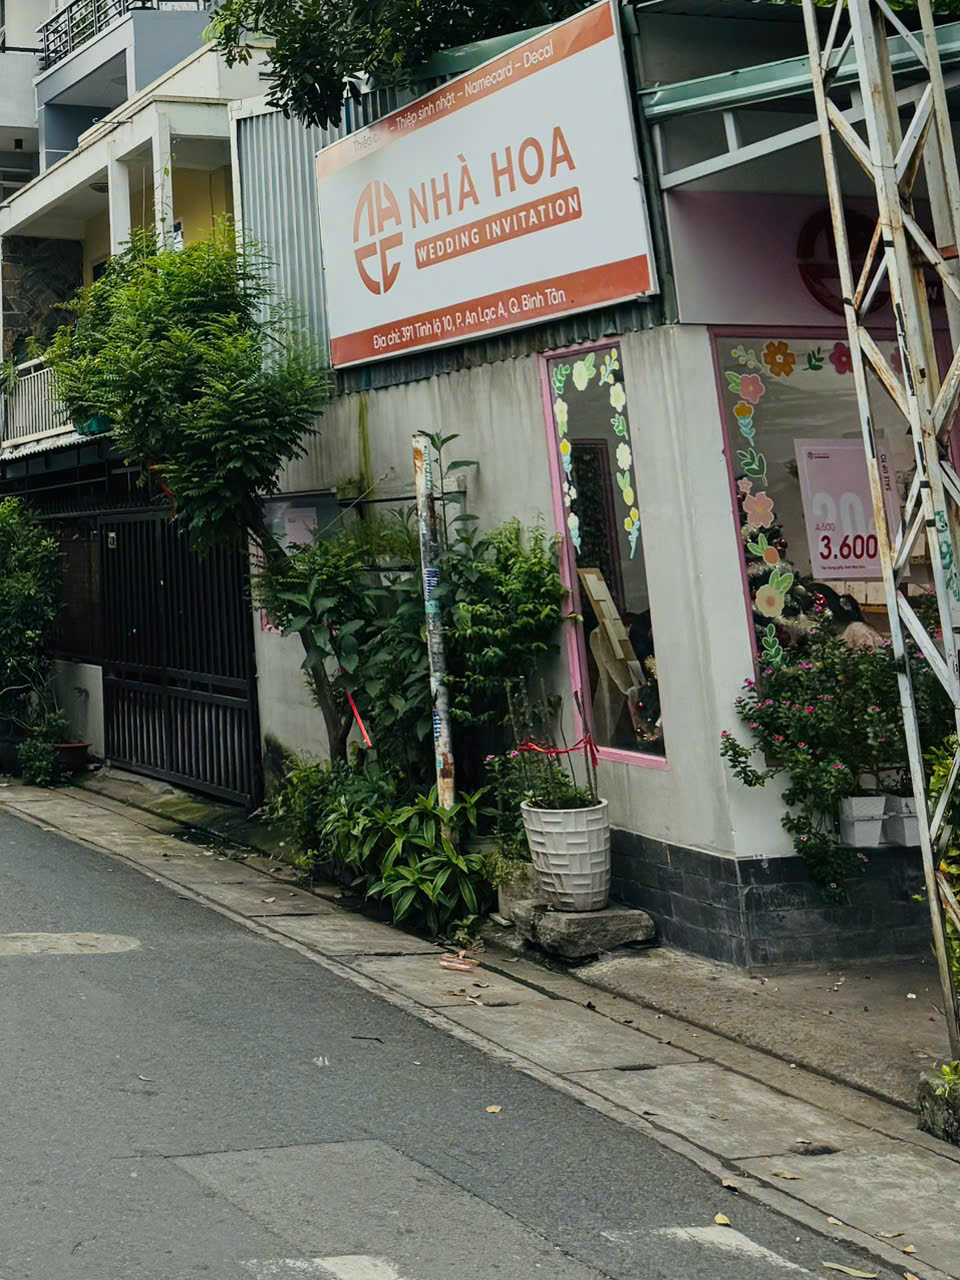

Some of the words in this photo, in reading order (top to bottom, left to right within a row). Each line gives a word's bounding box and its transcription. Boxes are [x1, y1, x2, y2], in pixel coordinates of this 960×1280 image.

[464, 62, 512, 97] Namecard
[523, 40, 554, 68] Decal
[408, 153, 480, 229] NHÀ
[490, 126, 576, 198] HOA
[417, 228, 480, 263] WEDDING
[486, 194, 579, 240] INVITATION
[401, 326, 415, 342] 391
[465, 310, 478, 325] An
[478, 306, 496, 324] Lạc
[545, 287, 566, 307] Tân
[820, 534, 879, 560] 3.600
